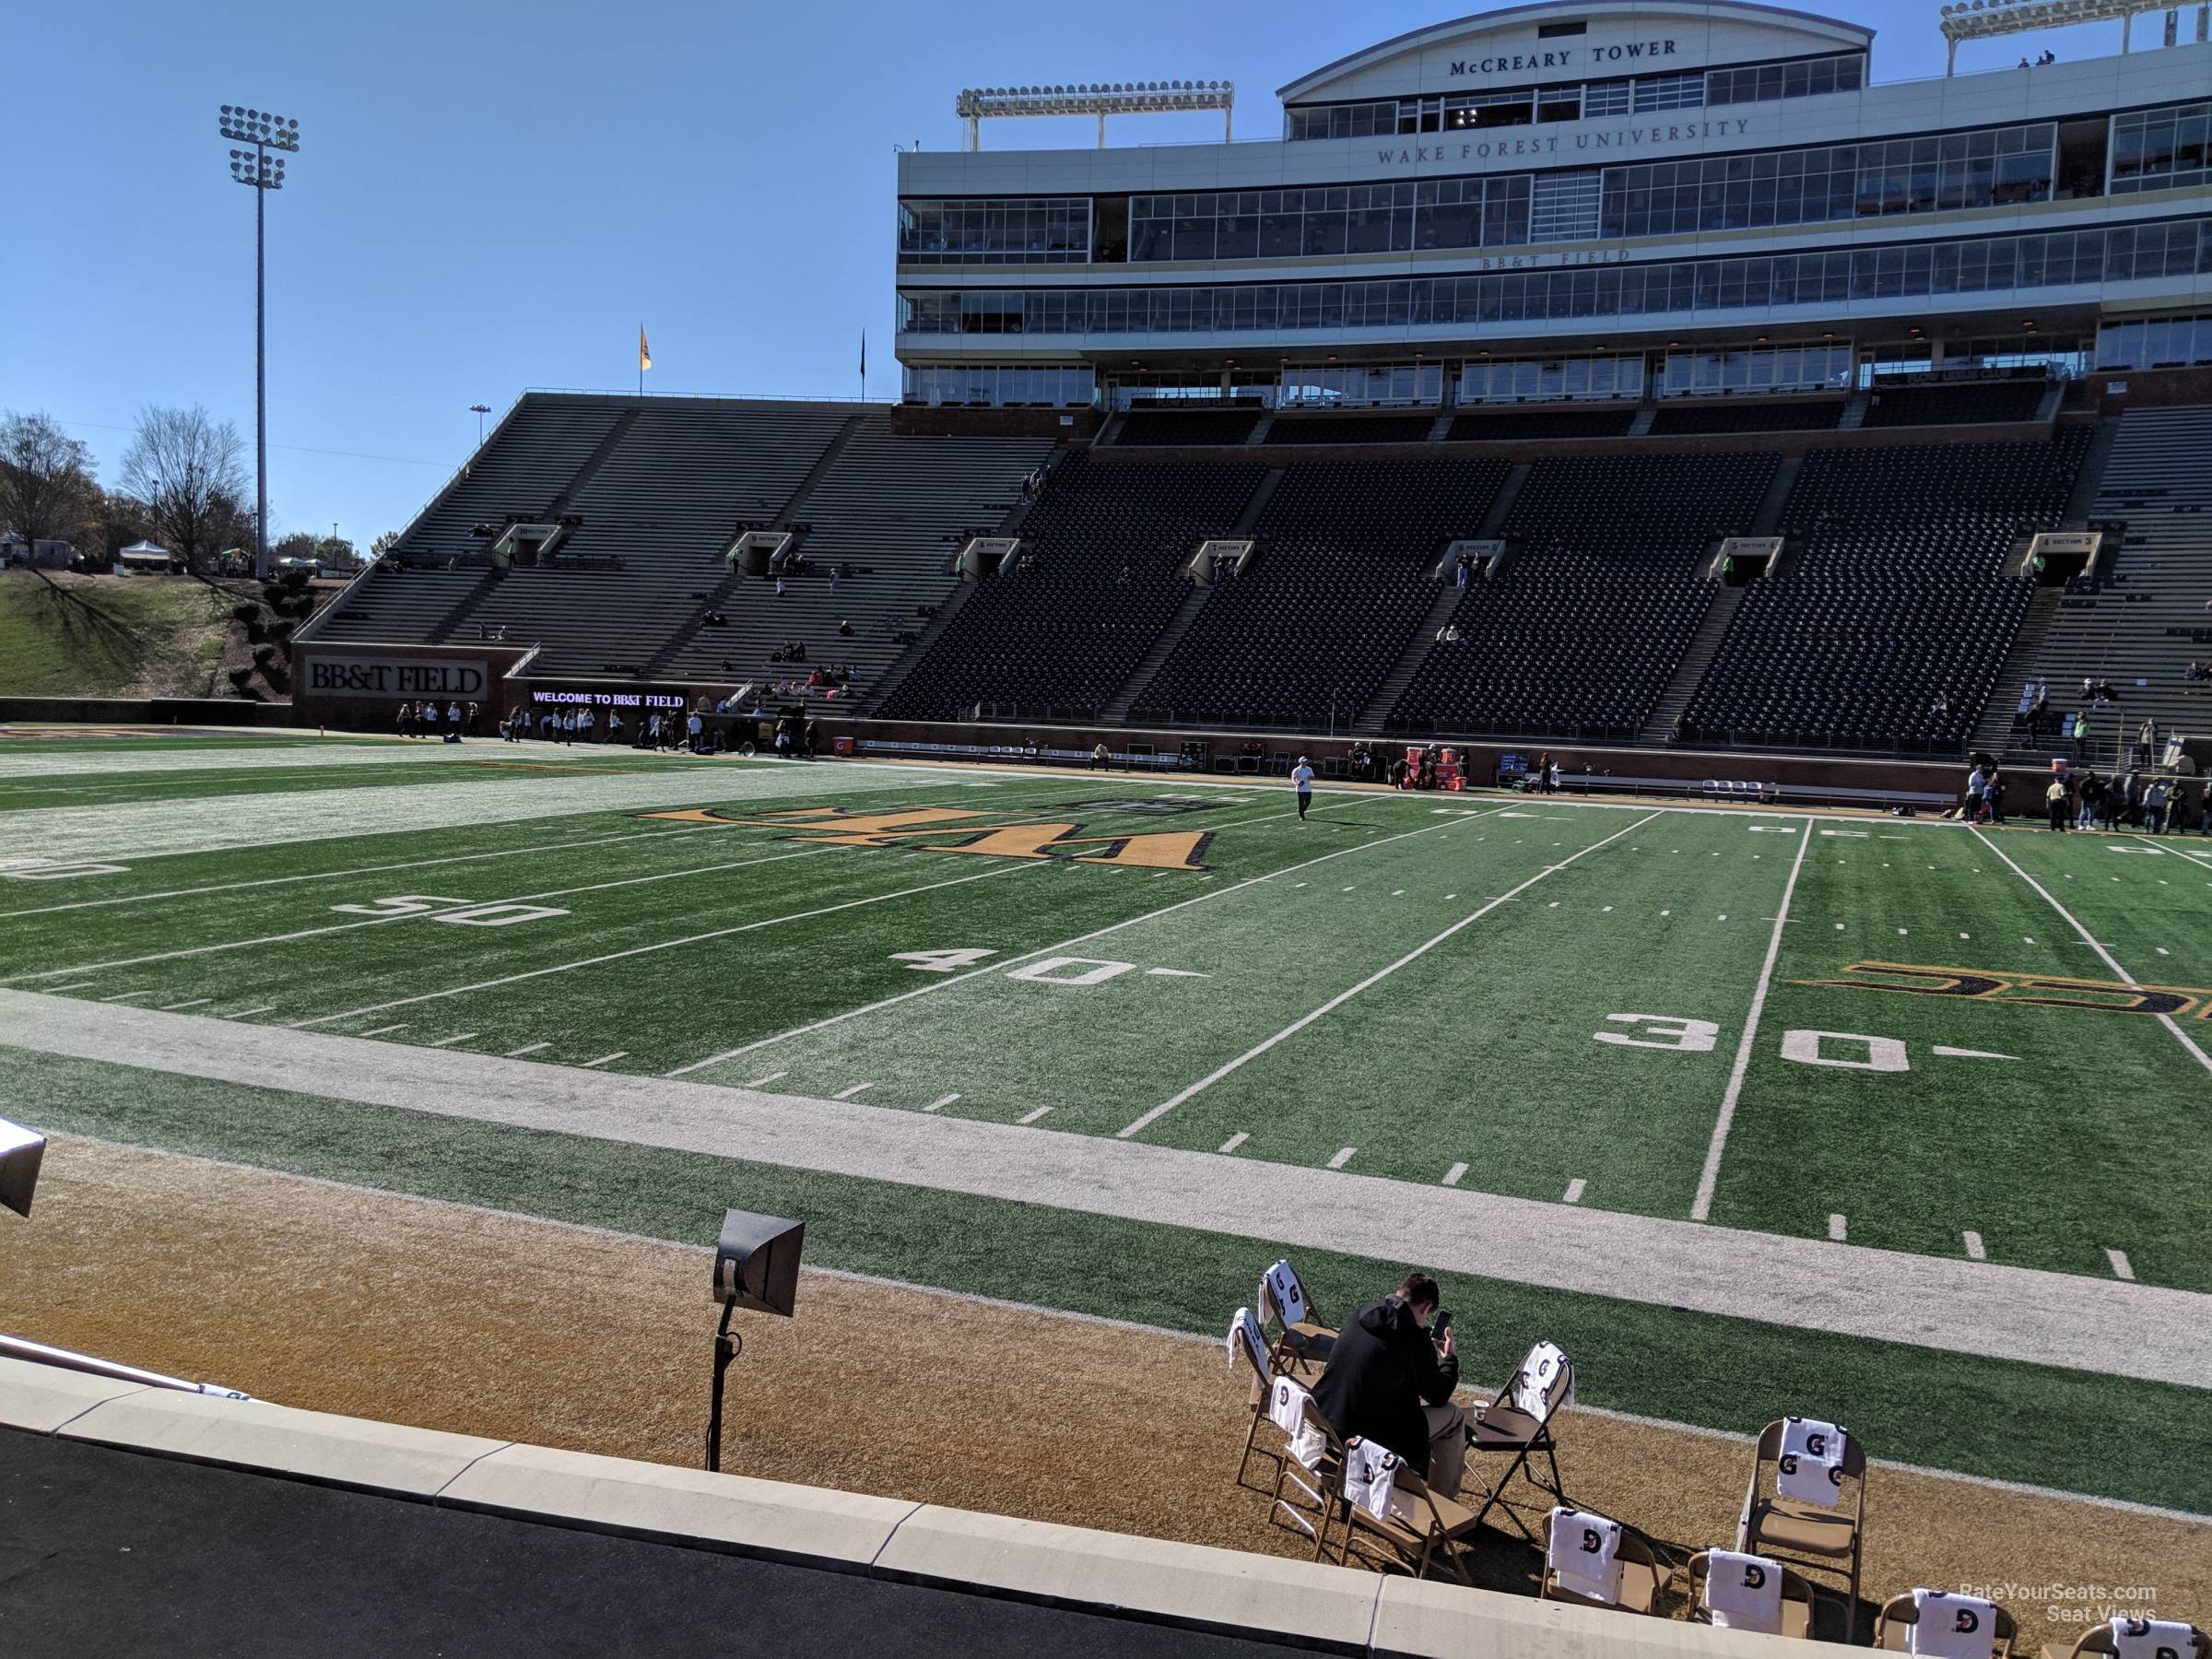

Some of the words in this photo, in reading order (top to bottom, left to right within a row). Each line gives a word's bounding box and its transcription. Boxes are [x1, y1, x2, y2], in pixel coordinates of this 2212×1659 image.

[1450, 51, 1571, 76] McCREARY
[1593, 40, 1677, 63] TOWER
[1378, 146, 1444, 164] WAKE
[1462, 137, 1558, 159] FOREST
[1576, 118, 1749, 149] UNIVERSITY
[1482, 255, 1540, 270] BB&T
[1561, 250, 1630, 265] FIELD
[311, 663, 393, 691] BB&T
[396, 665, 482, 694] FIELD
[534, 691, 593, 704] WELCOME
[594, 694, 611, 704] TO
[613, 694, 642, 706] BB&T
[646, 695, 684, 707] FIELD
[836, 741, 844, 750] G
[1288, 1284, 1300, 1303] G
[1539, 1359, 1550, 1377] G
[1279, 1385, 1289, 1406] G
[1477, 1411, 1486, 1420] G
[1806, 1433, 1826, 1456] G
[1779, 1453, 1797, 1475] G
[1582, 1528, 1602, 1554] G
[1744, 1563, 1766, 1589] G
[1955, 1608, 1979, 1633] G
